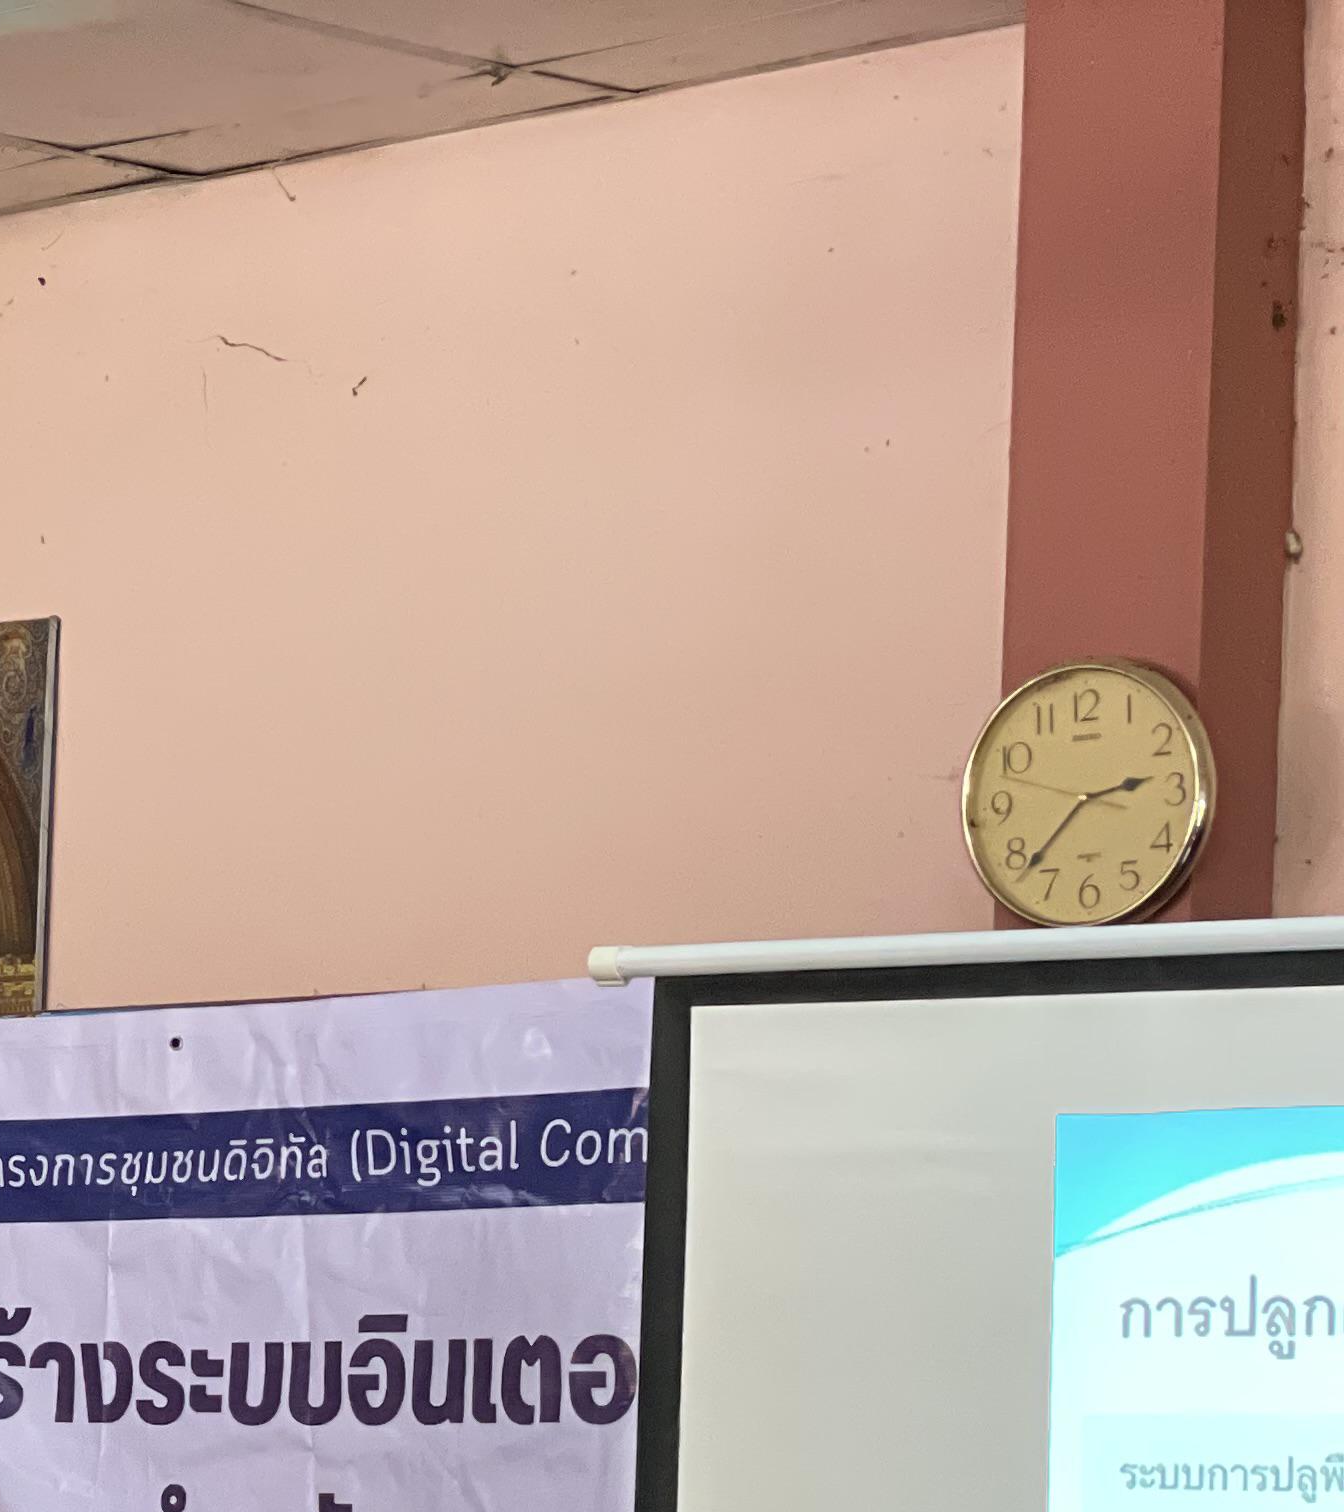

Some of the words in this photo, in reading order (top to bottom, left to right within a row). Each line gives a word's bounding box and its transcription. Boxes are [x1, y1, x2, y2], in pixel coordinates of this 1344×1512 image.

[1036, 704, 1054, 735] 11
[1074, 688, 1101, 723] 12
[1152, 723, 1173, 756] 2
[1003, 742, 1032, 775] 10
[1163, 772, 1187, 807] 3
[991, 791, 1013, 825] 9
[1005, 837, 1027, 870] 8
[1150, 821, 1173, 853] 4
[1039, 868, 1060, 901] 7
[1078, 874, 1101, 909] 6
[1119, 860, 1140, 890] 5
[351, 1119, 520, 1187] (Digital
[540, 1118, 649, 1168] Com
[1119, 1274, 1344, 1360] การปลูก
